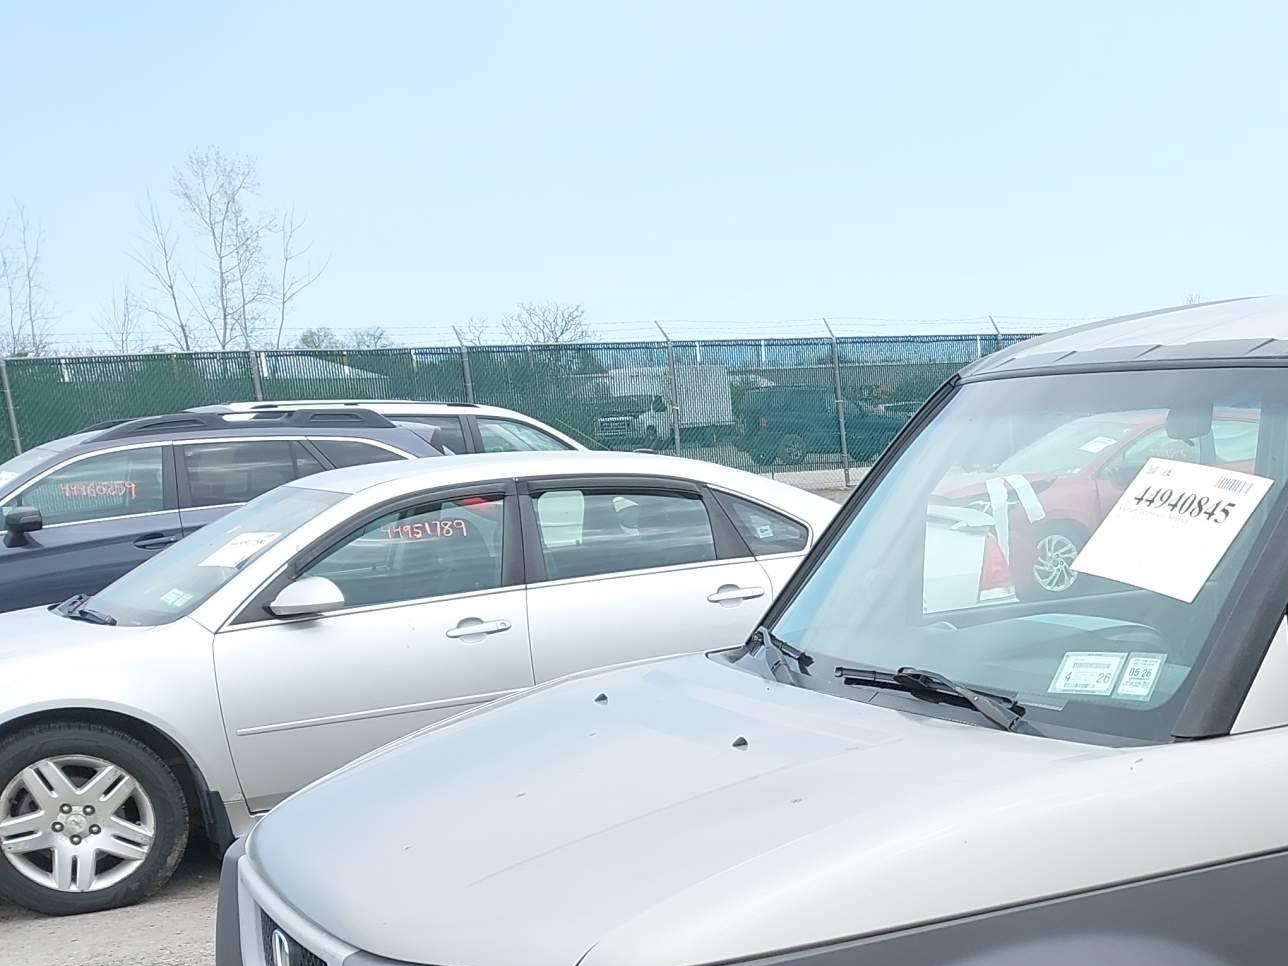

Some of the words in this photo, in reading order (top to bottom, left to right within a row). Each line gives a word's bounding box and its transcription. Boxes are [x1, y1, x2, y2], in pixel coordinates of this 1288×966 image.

[1134, 486, 1236, 524] 44940845
[381, 519, 467, 539] 44951789
[1064, 671, 1073, 681] 4
[1096, 672, 1112, 684] 26
